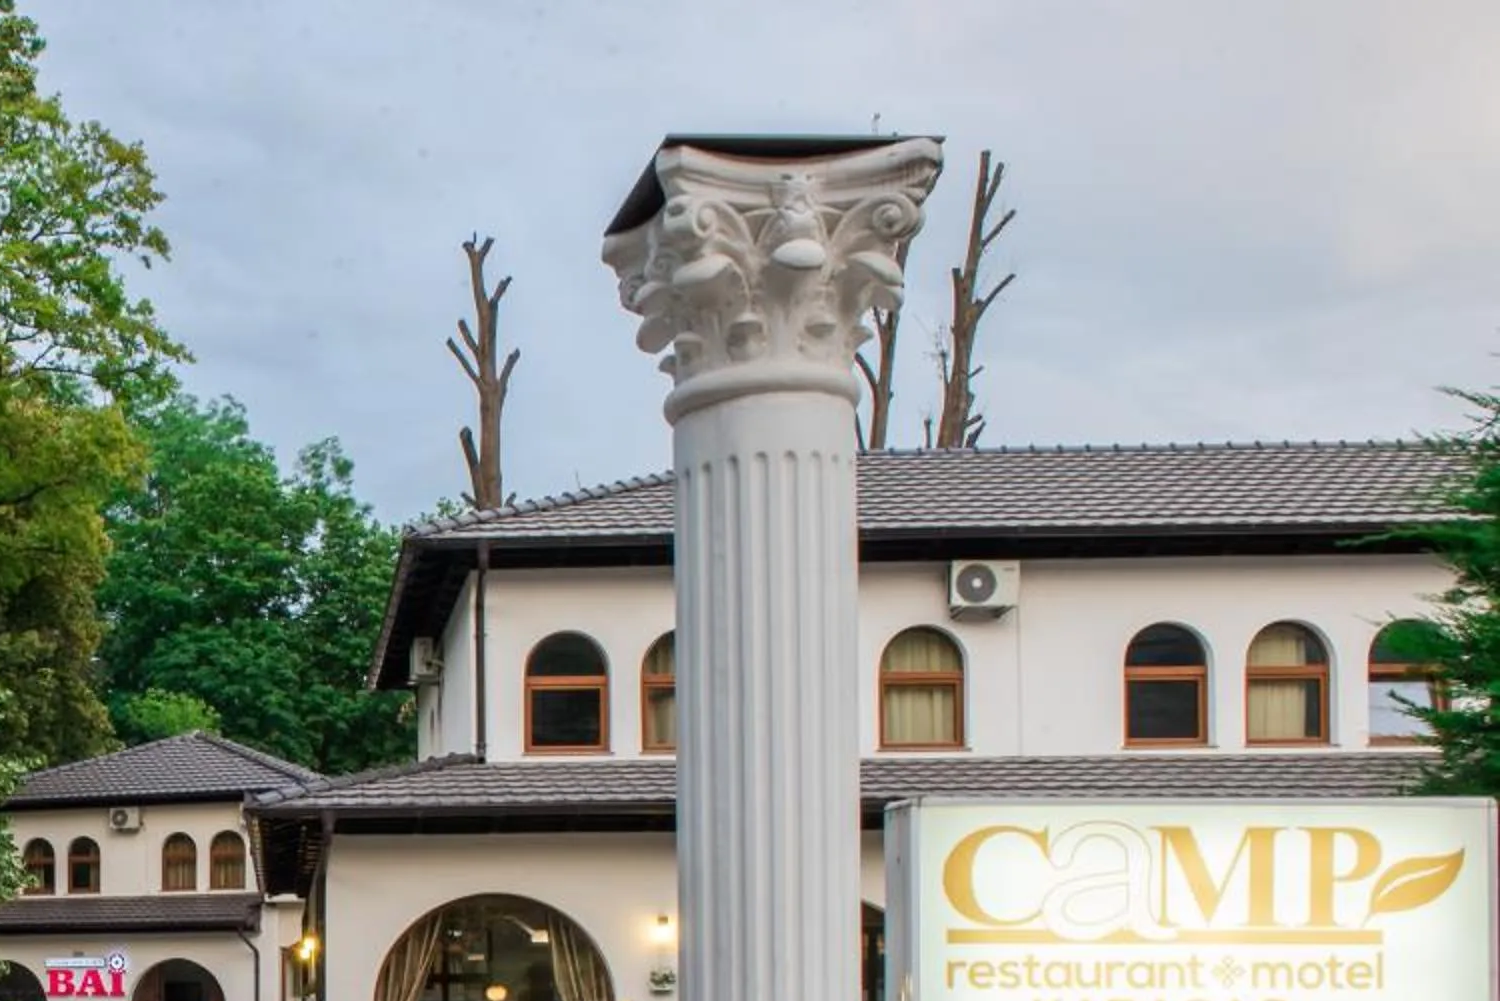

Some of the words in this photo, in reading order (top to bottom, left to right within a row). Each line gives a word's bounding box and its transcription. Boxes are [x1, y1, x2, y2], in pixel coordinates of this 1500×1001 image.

[46, 968, 127, 998] BAI
[946, 953, 1201, 990] restaurant
[1251, 952, 1384, 990] motel
